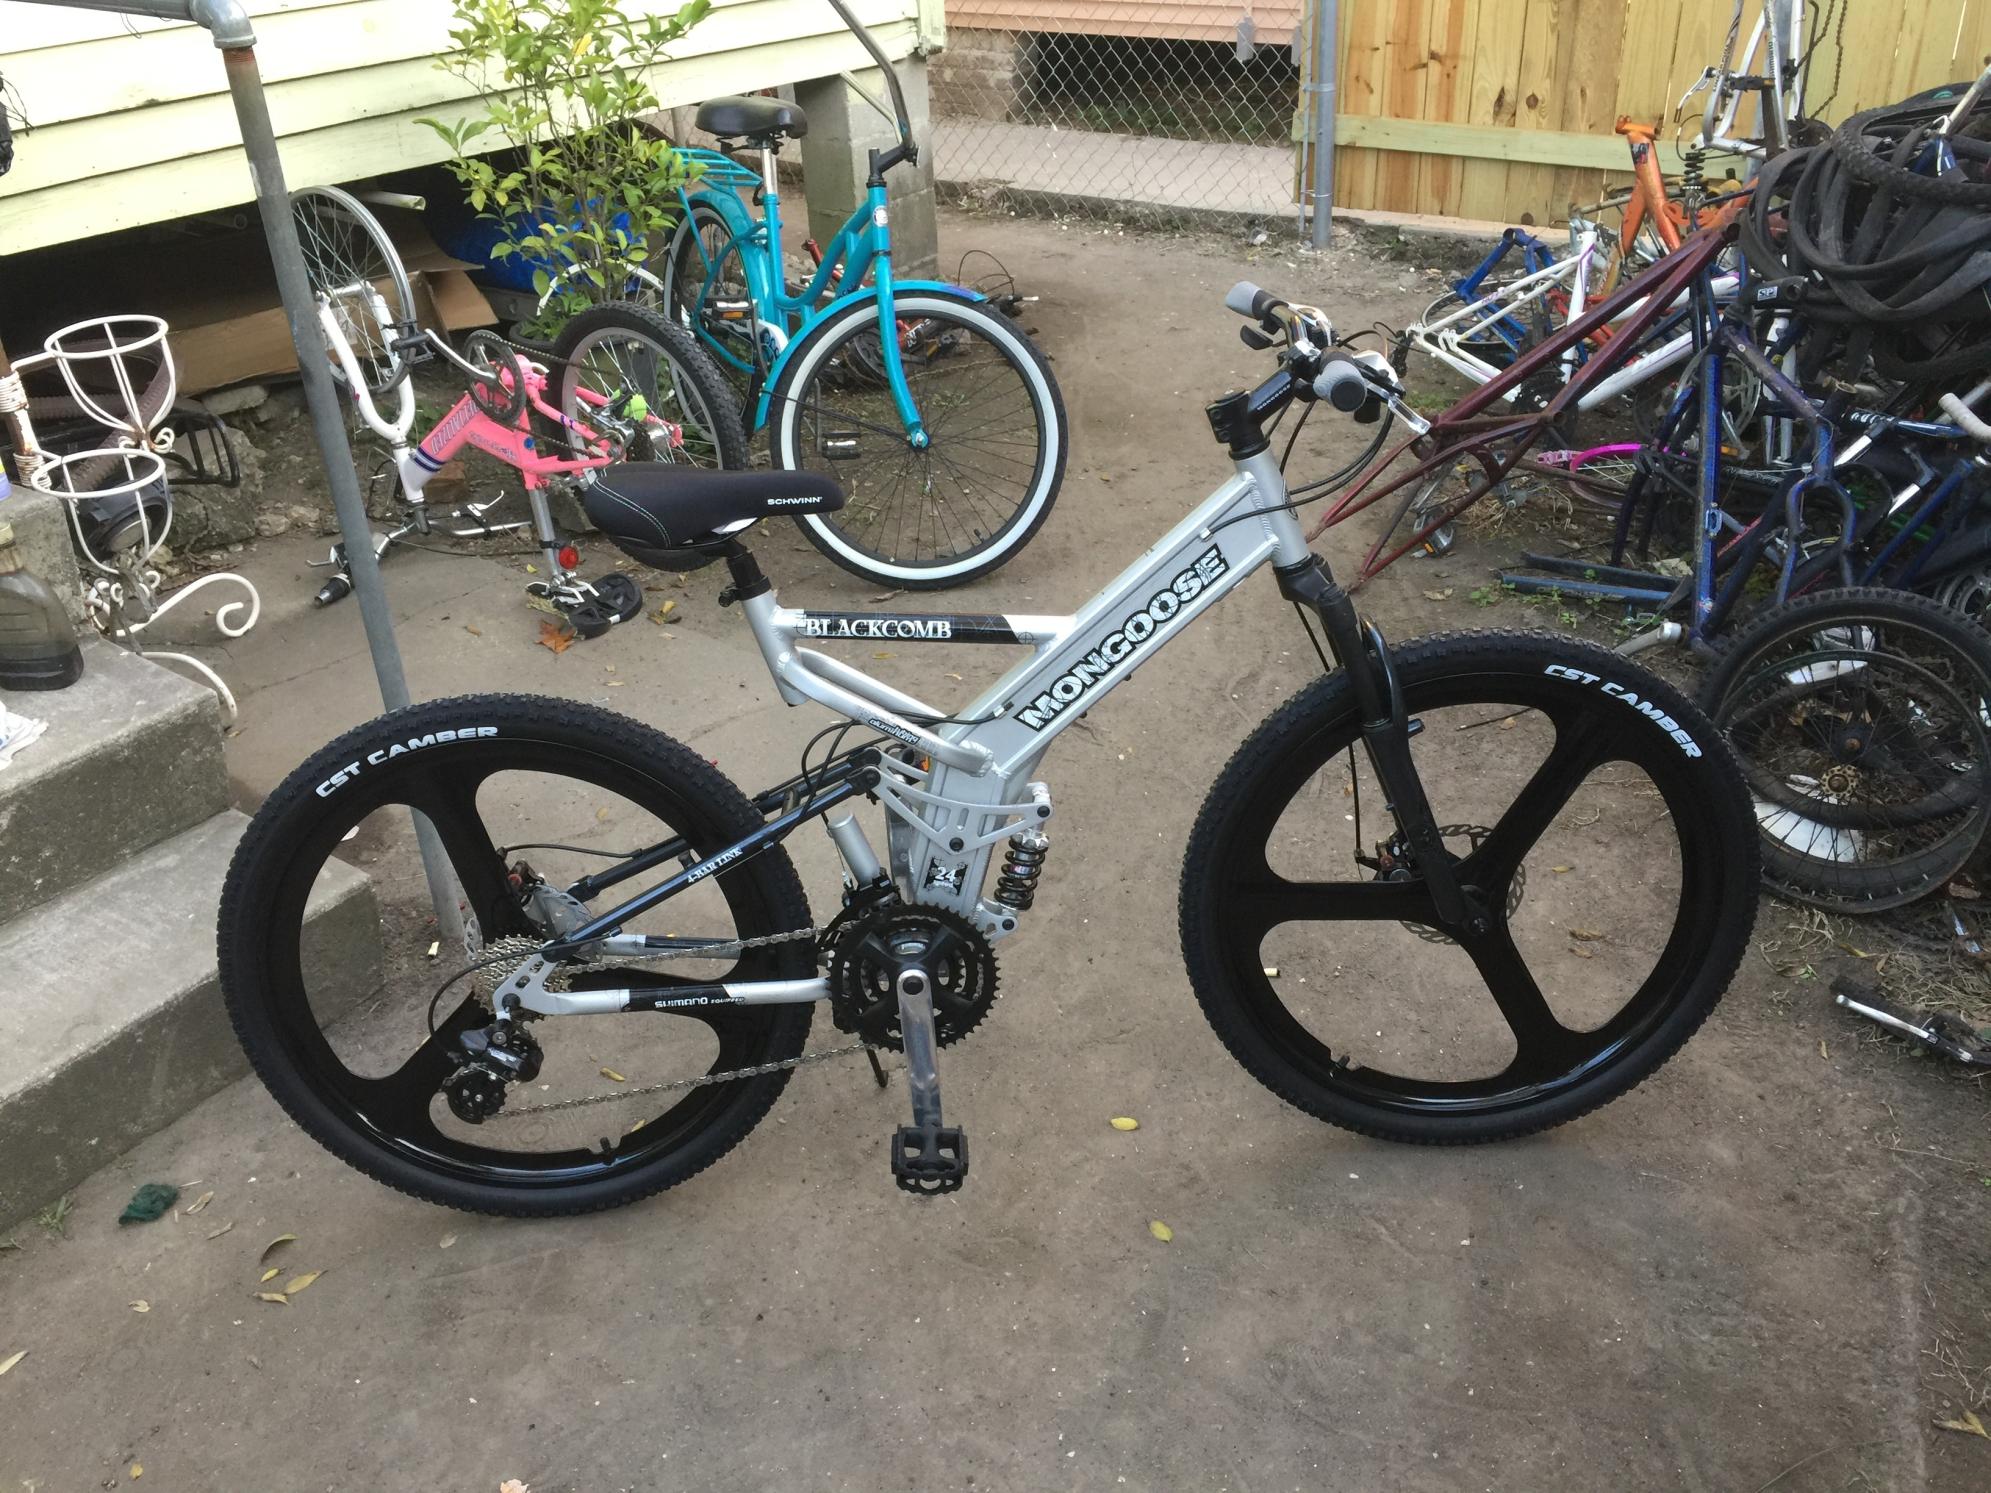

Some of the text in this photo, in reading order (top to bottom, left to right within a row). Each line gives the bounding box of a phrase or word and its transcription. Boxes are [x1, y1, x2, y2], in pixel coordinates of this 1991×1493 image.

[767, 497, 821, 505] SCHWINN
[805, 618, 952, 639] BLACKCOMB
[1014, 543, 1230, 732] MONGOOSE
[1544, 664, 1703, 758] CST CAMBER
[315, 726, 499, 798] CST CAMBER
[716, 846, 744, 866] LINK
[934, 866, 957, 882] 24
[654, 997, 708, 1009] SHIMANO
